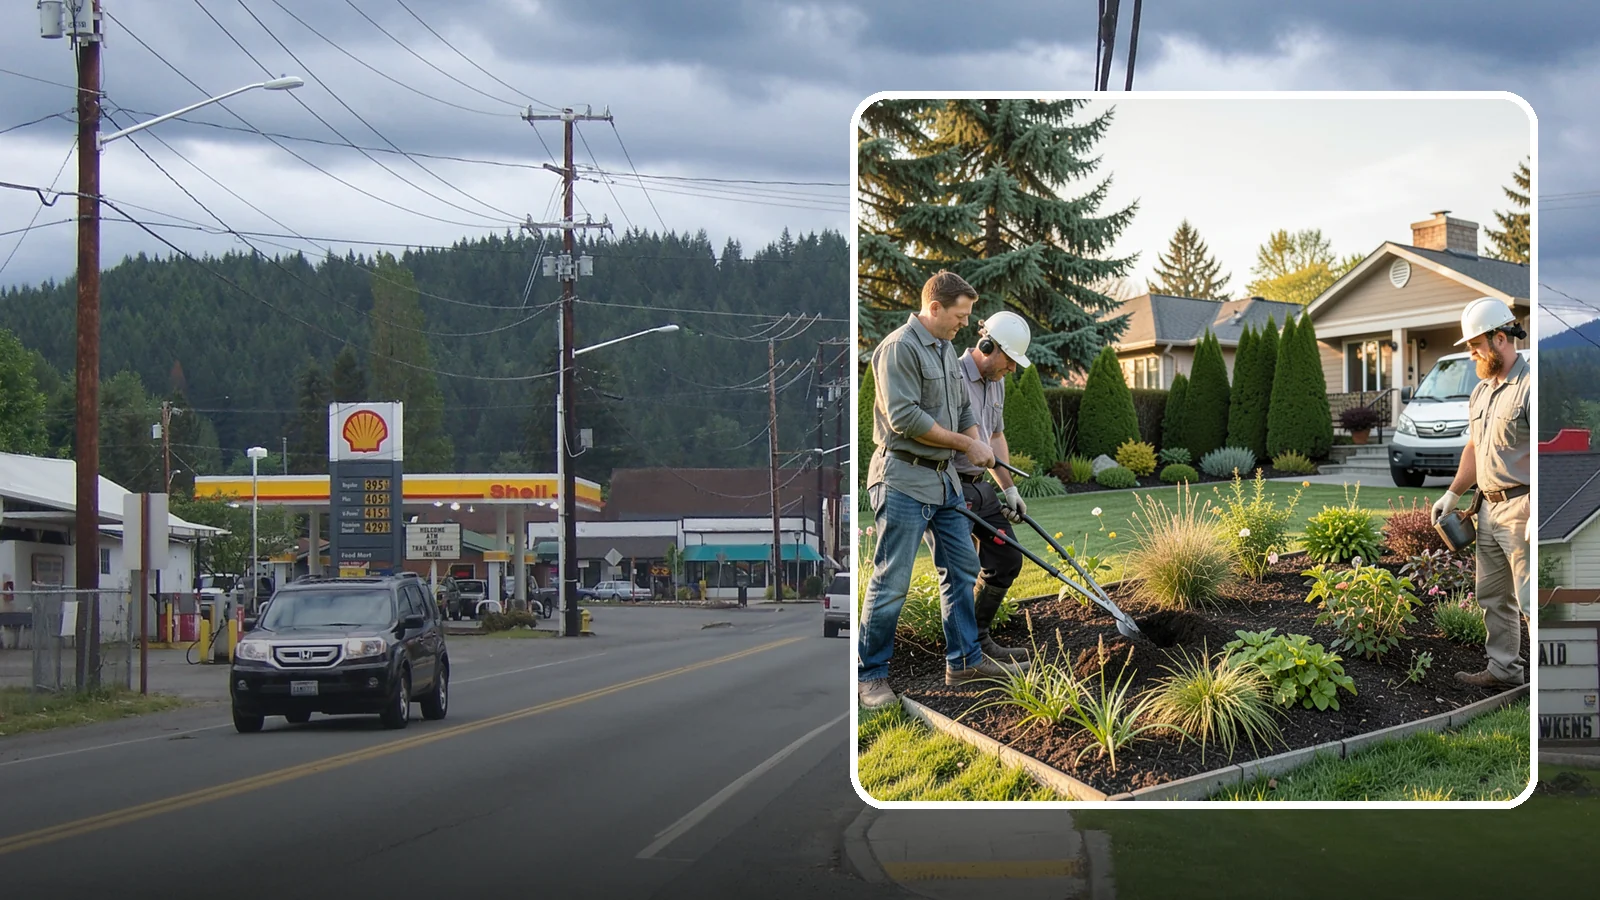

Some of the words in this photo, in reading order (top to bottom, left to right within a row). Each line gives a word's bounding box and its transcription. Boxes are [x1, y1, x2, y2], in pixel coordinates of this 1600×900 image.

[365, 480, 383, 490] 395
[490, 484, 547, 498] Shell
[365, 494, 383, 504] 405
[365, 508, 383, 518] 415
[365, 523, 383, 533] 429
